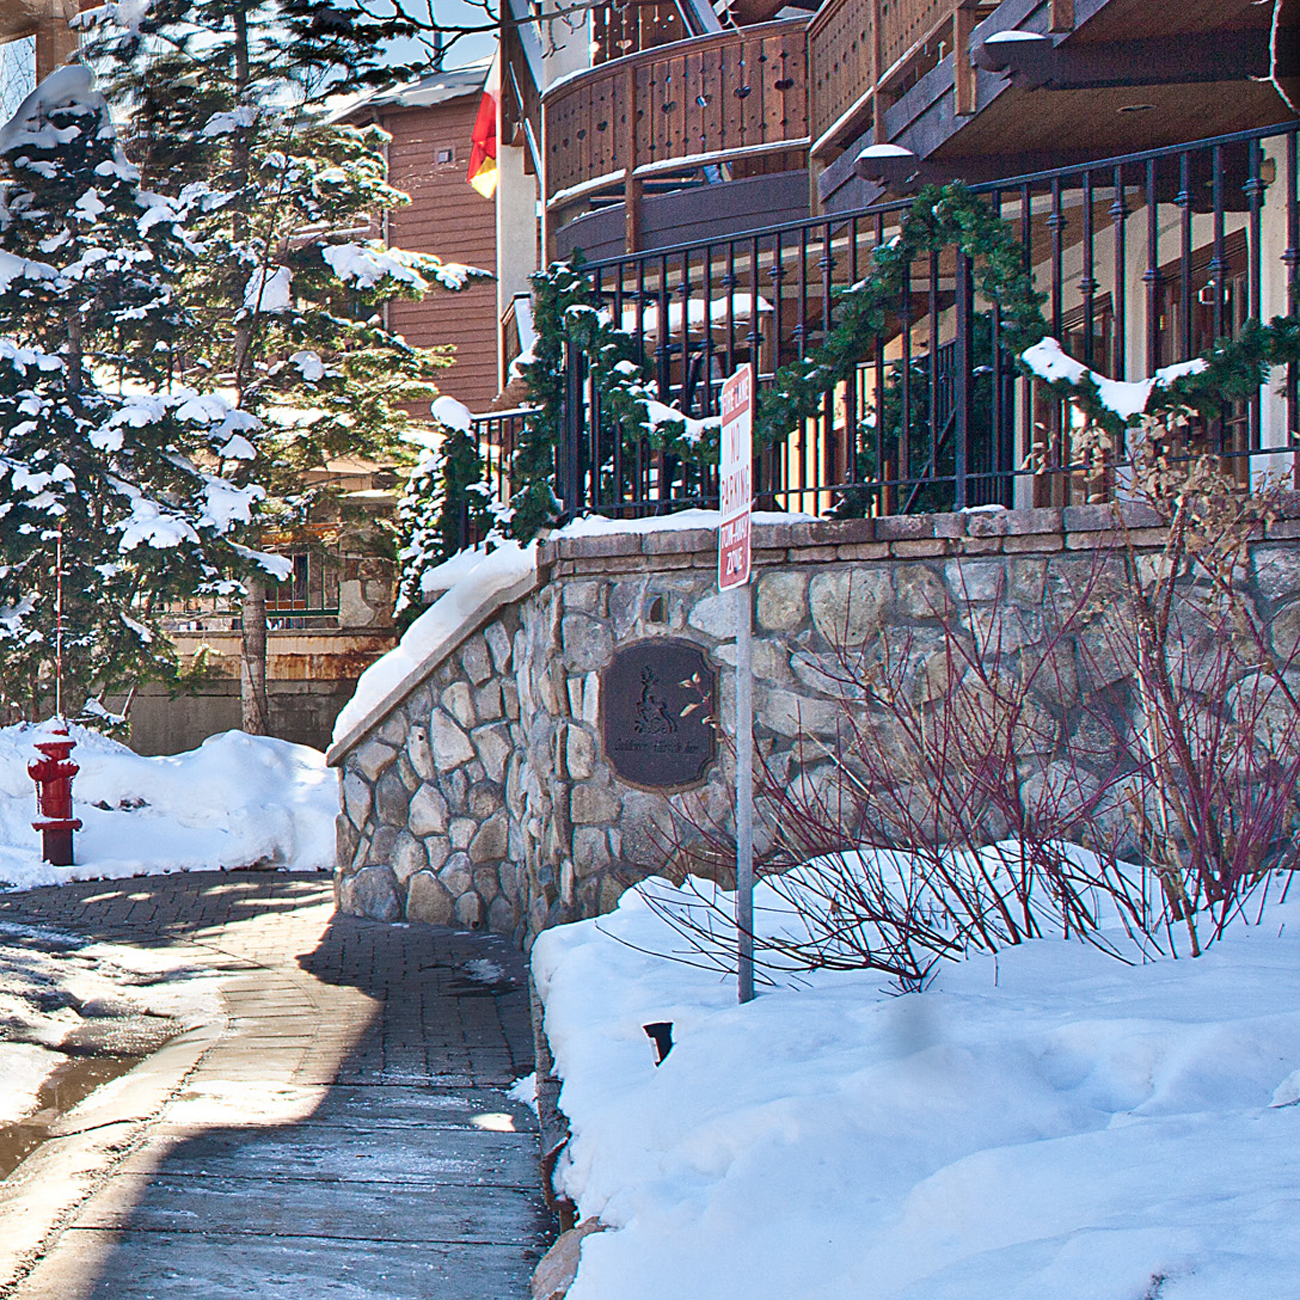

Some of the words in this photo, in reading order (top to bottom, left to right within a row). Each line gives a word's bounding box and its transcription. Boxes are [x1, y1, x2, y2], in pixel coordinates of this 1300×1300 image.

[722, 386, 736, 417] FIRE
[735, 375, 749, 408] LANE
[731, 422, 740, 465] NO
[721, 463, 749, 517] PARKING
[726, 545, 743, 576] ZONE
